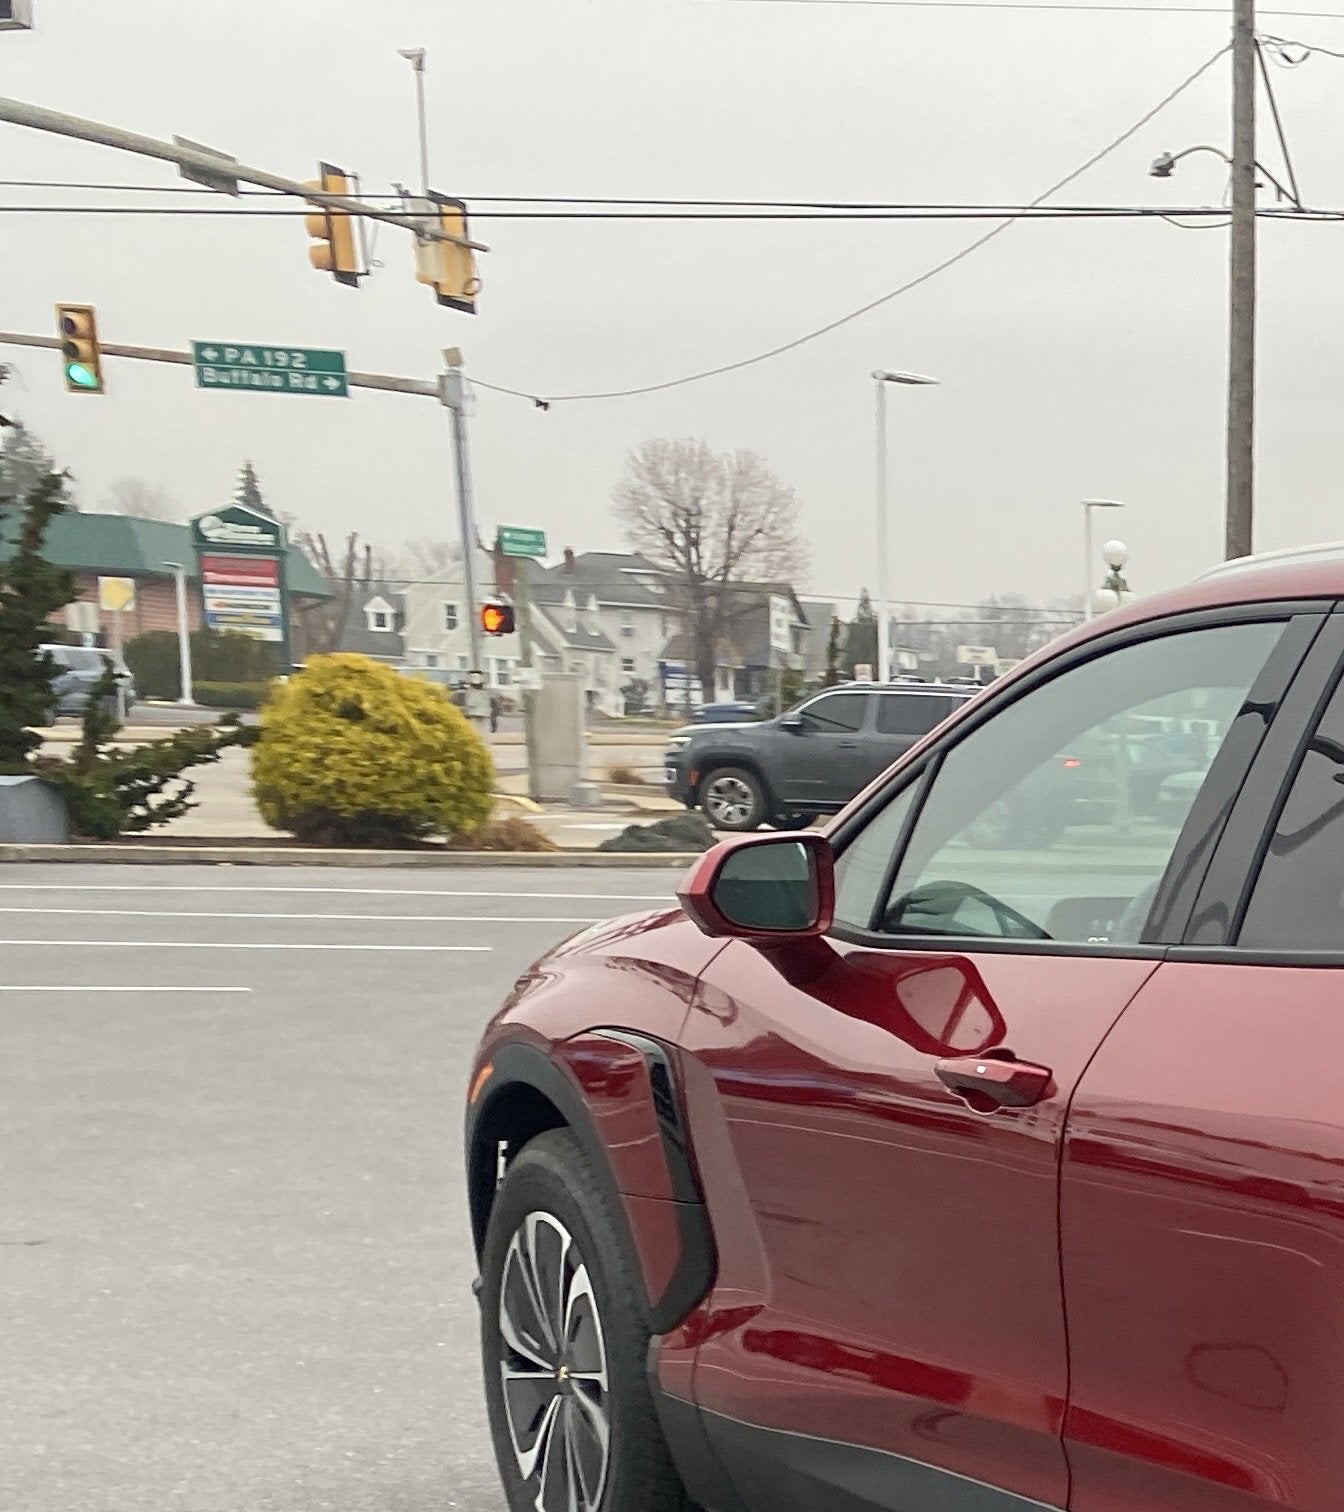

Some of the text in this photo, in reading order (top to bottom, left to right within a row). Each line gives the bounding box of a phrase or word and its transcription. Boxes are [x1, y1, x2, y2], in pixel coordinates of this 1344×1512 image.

[224, 347, 307, 368] PA 192
[203, 367, 318, 390] Buffalo Rd
